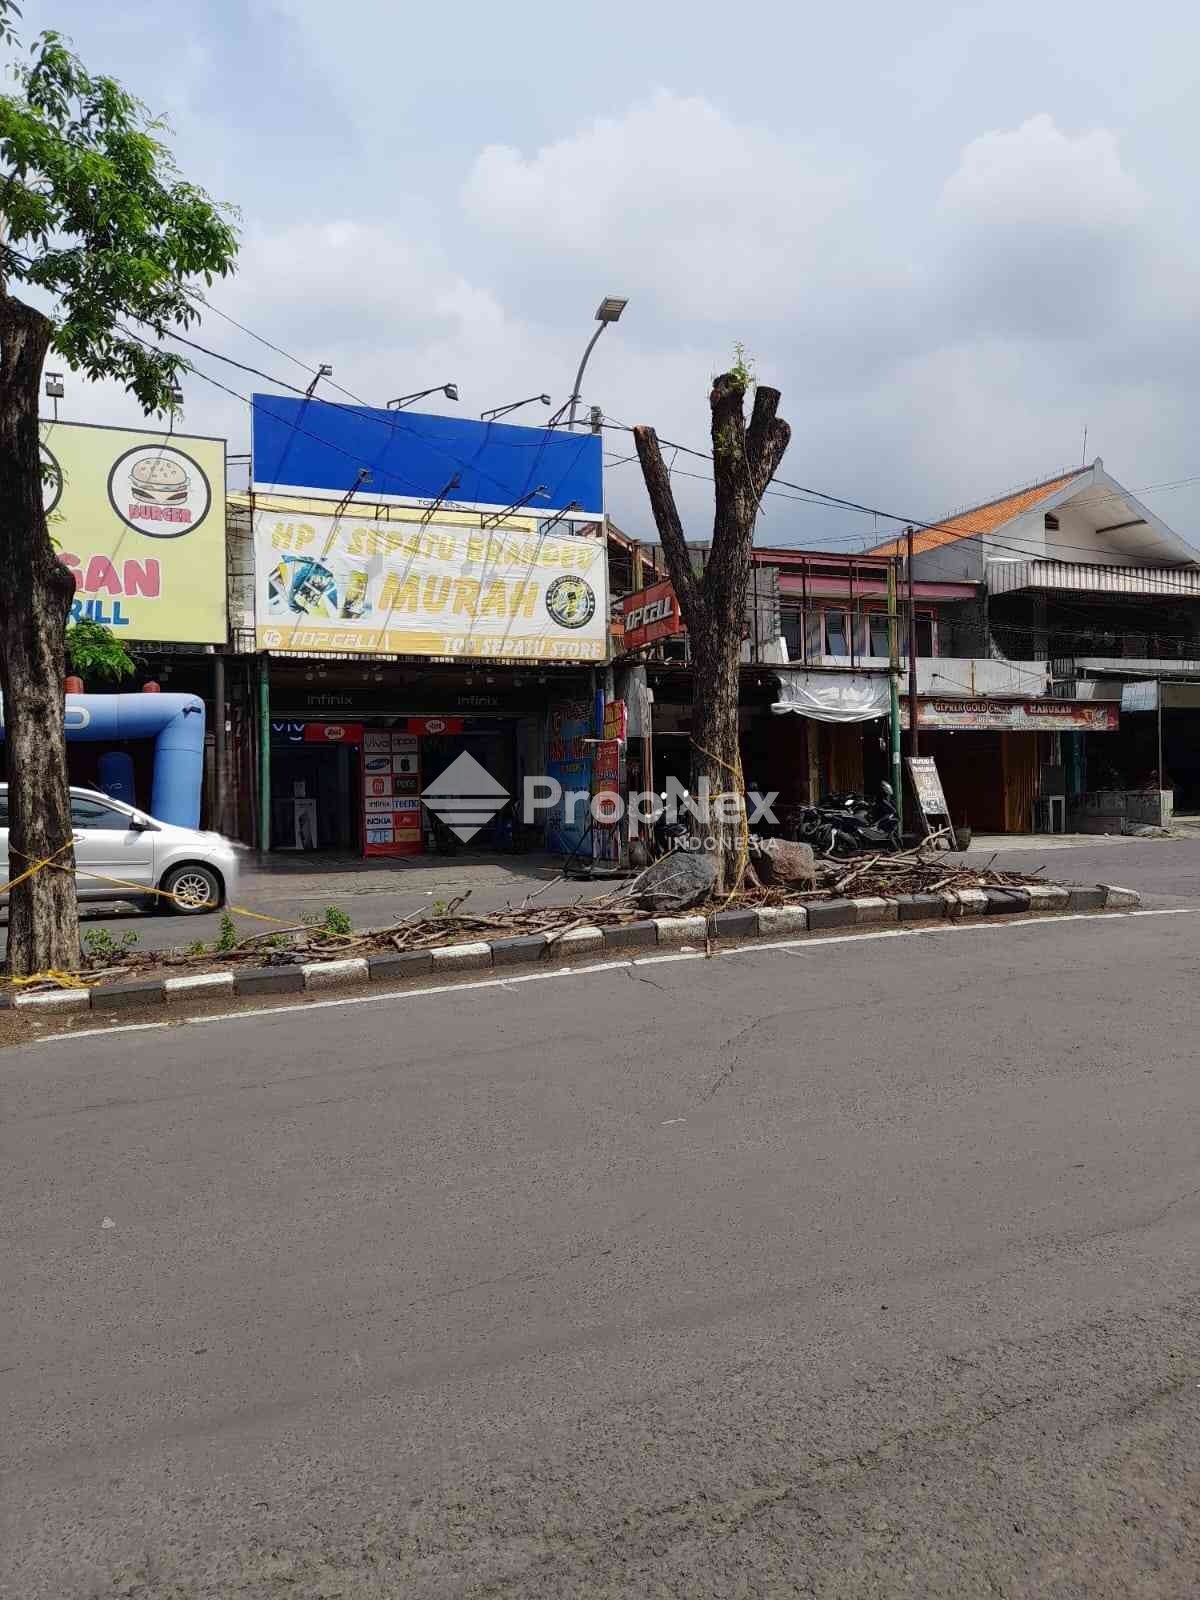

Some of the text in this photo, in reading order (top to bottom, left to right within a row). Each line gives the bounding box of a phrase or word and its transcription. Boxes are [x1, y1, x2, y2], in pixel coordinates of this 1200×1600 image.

[128, 503, 193, 524] BURGER
[271, 521, 316, 551] HP
[376, 570, 541, 618] MURAH
[551, 641, 600, 657] STORE
[965, 702, 987, 713] GOLD
